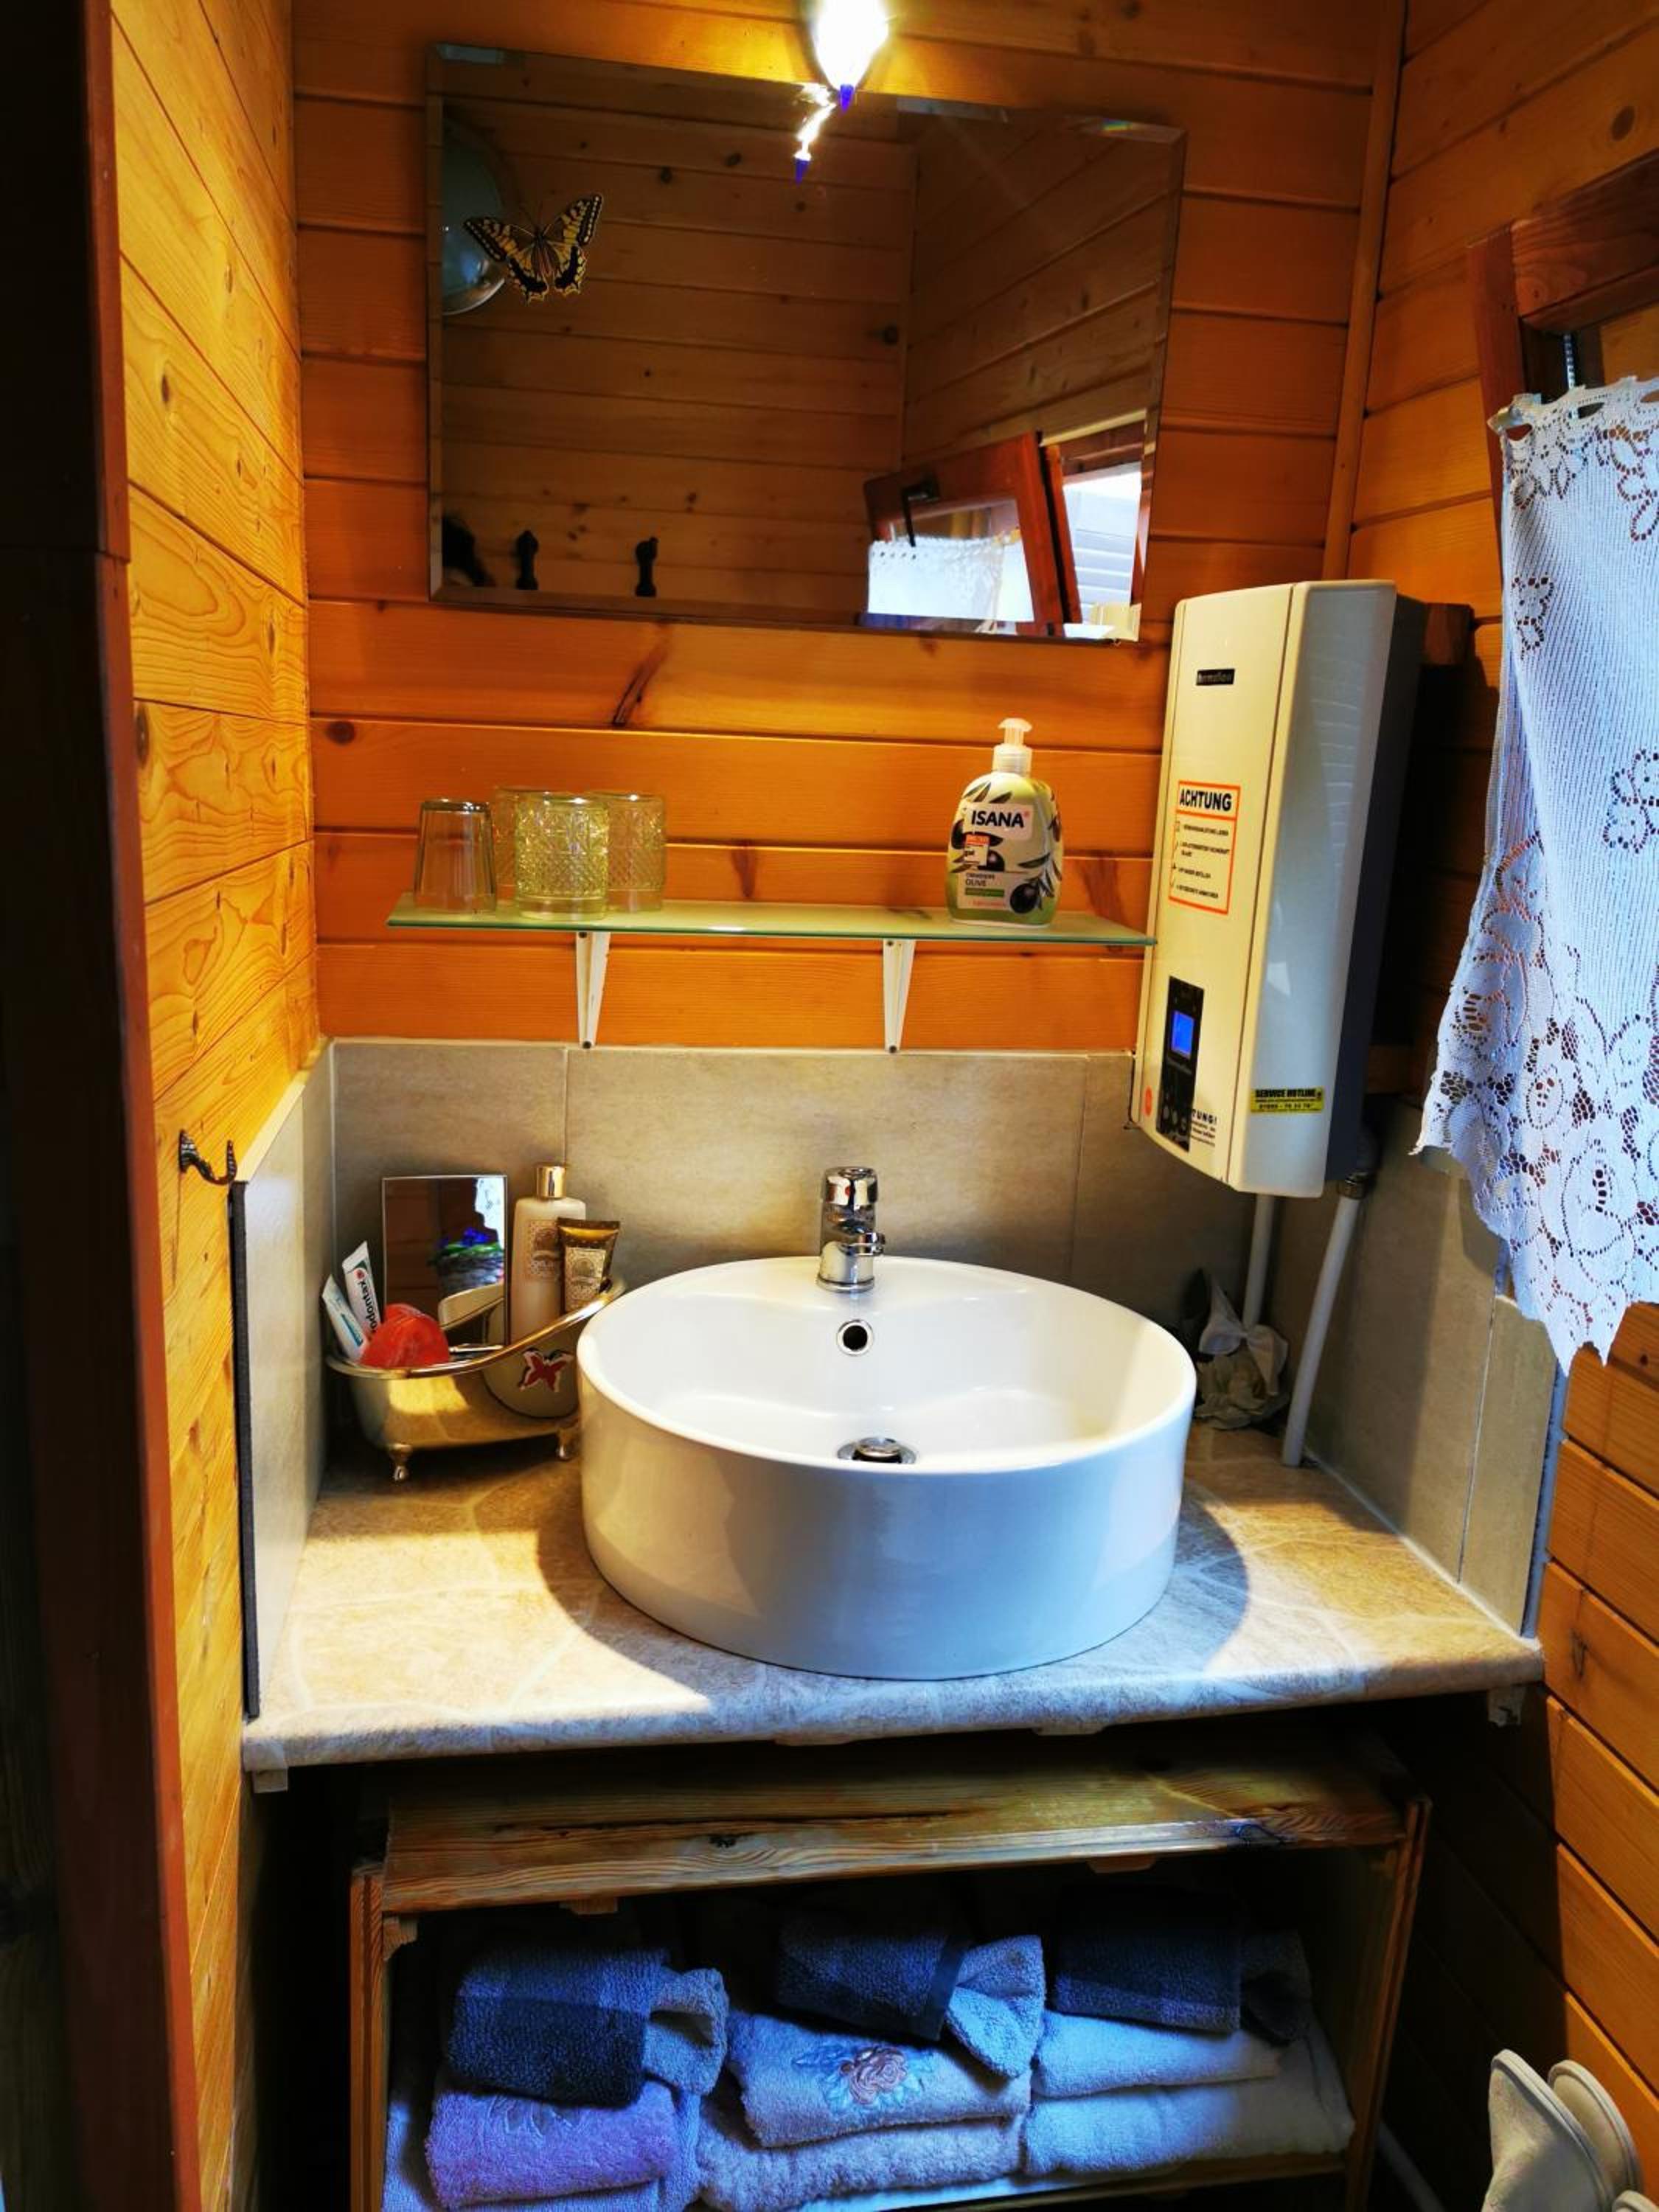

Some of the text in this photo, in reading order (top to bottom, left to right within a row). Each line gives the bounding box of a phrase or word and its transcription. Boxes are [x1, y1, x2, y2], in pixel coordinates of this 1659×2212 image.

[1179, 788, 1232, 811] ACHTUNG
[971, 810, 1024, 827] ISANA
[1192, 1108, 1217, 1125] TUNG!
[358, 1280, 378, 1333] odontax
